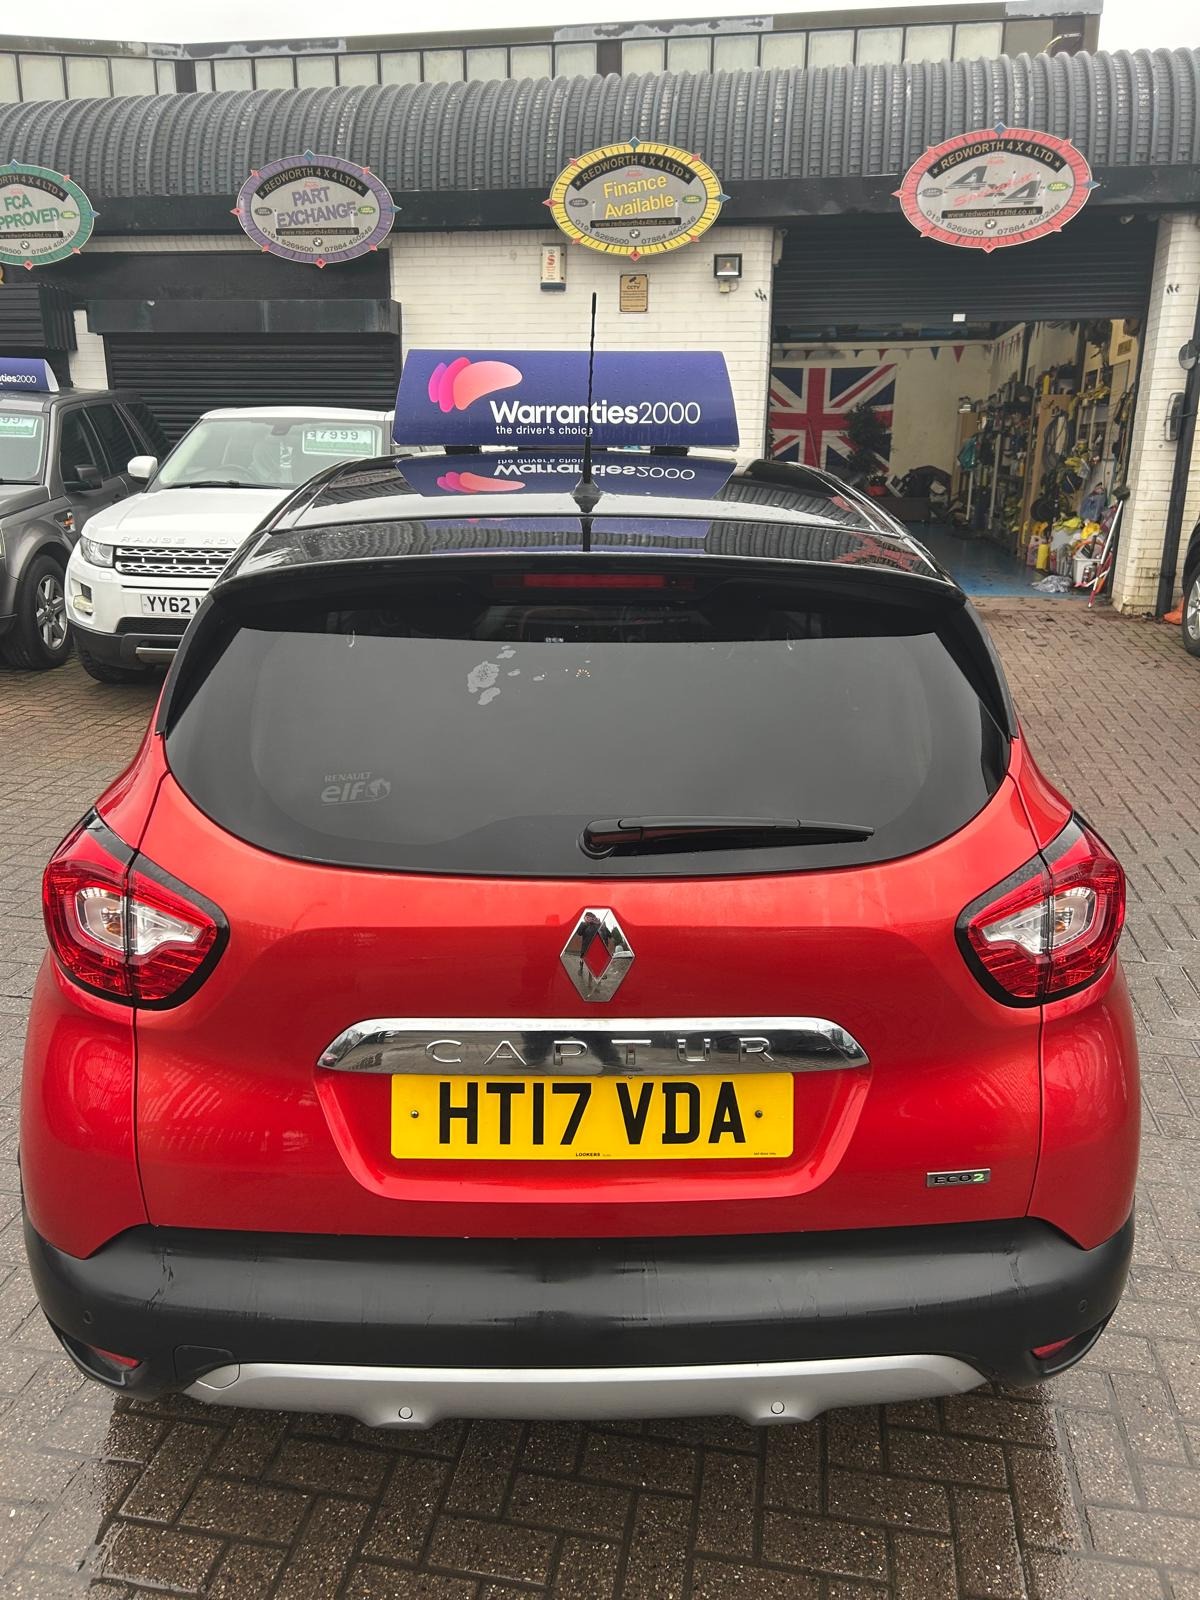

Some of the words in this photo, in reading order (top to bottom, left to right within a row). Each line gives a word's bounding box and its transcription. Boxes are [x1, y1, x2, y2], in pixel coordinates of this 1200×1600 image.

[941, 141, 1004, 169] REDWORTH
[1007, 141, 1014, 150] 4
[1017, 142, 1024, 151] X
[1025, 143, 1032, 153] 4
[1033, 145, 1054, 162] LTD
[264, 167, 314, 193] REDWORTH
[316, 167, 322, 176] 4
[324, 168, 330, 178] X
[332, 170, 337, 179] 4
[339, 173, 357, 188] LTD
[582, 155, 638, 182] REDWORTH
[640, 155, 646, 164] 4
[649, 156, 656, 166] X
[658, 158, 664, 168] 4
[665, 161, 684, 176] LTD
[28, 176, 34, 184] X
[36, 178, 41, 186] 4
[42, 181, 58, 194] LTD
[292, 186, 330, 207] PART
[603, 175, 668, 199] Finance
[4, 194, 32, 211] FCA
[276, 201, 358, 228] EXCHANGE
[604, 195, 675, 220] Available
[575, 219, 594, 234] 0191
[594, 231, 630, 245] 5269500
[641, 234, 667, 245] 07884
[668, 216, 696, 237] 450246
[926, 210, 944, 225] 0191
[946, 223, 984, 236] 5269500
[997, 223, 1026, 235] 07884
[1028, 205, 1060, 227] 450246
[262, 227, 280, 241] 0191
[324, 243, 347, 253] 07884
[0, 373, 37, 383] ties2000
[489, 400, 701, 424] Warranties2000
[496, 425, 513, 435] the
[516, 425, 555, 435] driver's
[559, 425, 593, 435] choice
[120, 536, 185, 545] RANGE
[147, 596, 190, 613] YY62
[325, 771, 372, 783] RENAULT
[321, 781, 366, 802] elf
[425, 1037, 775, 1066] CAPTUR
[438, 1081, 594, 1146] HT17
[615, 1081, 747, 1146] VDA
[934, 1173, 985, 1185] ECO2
